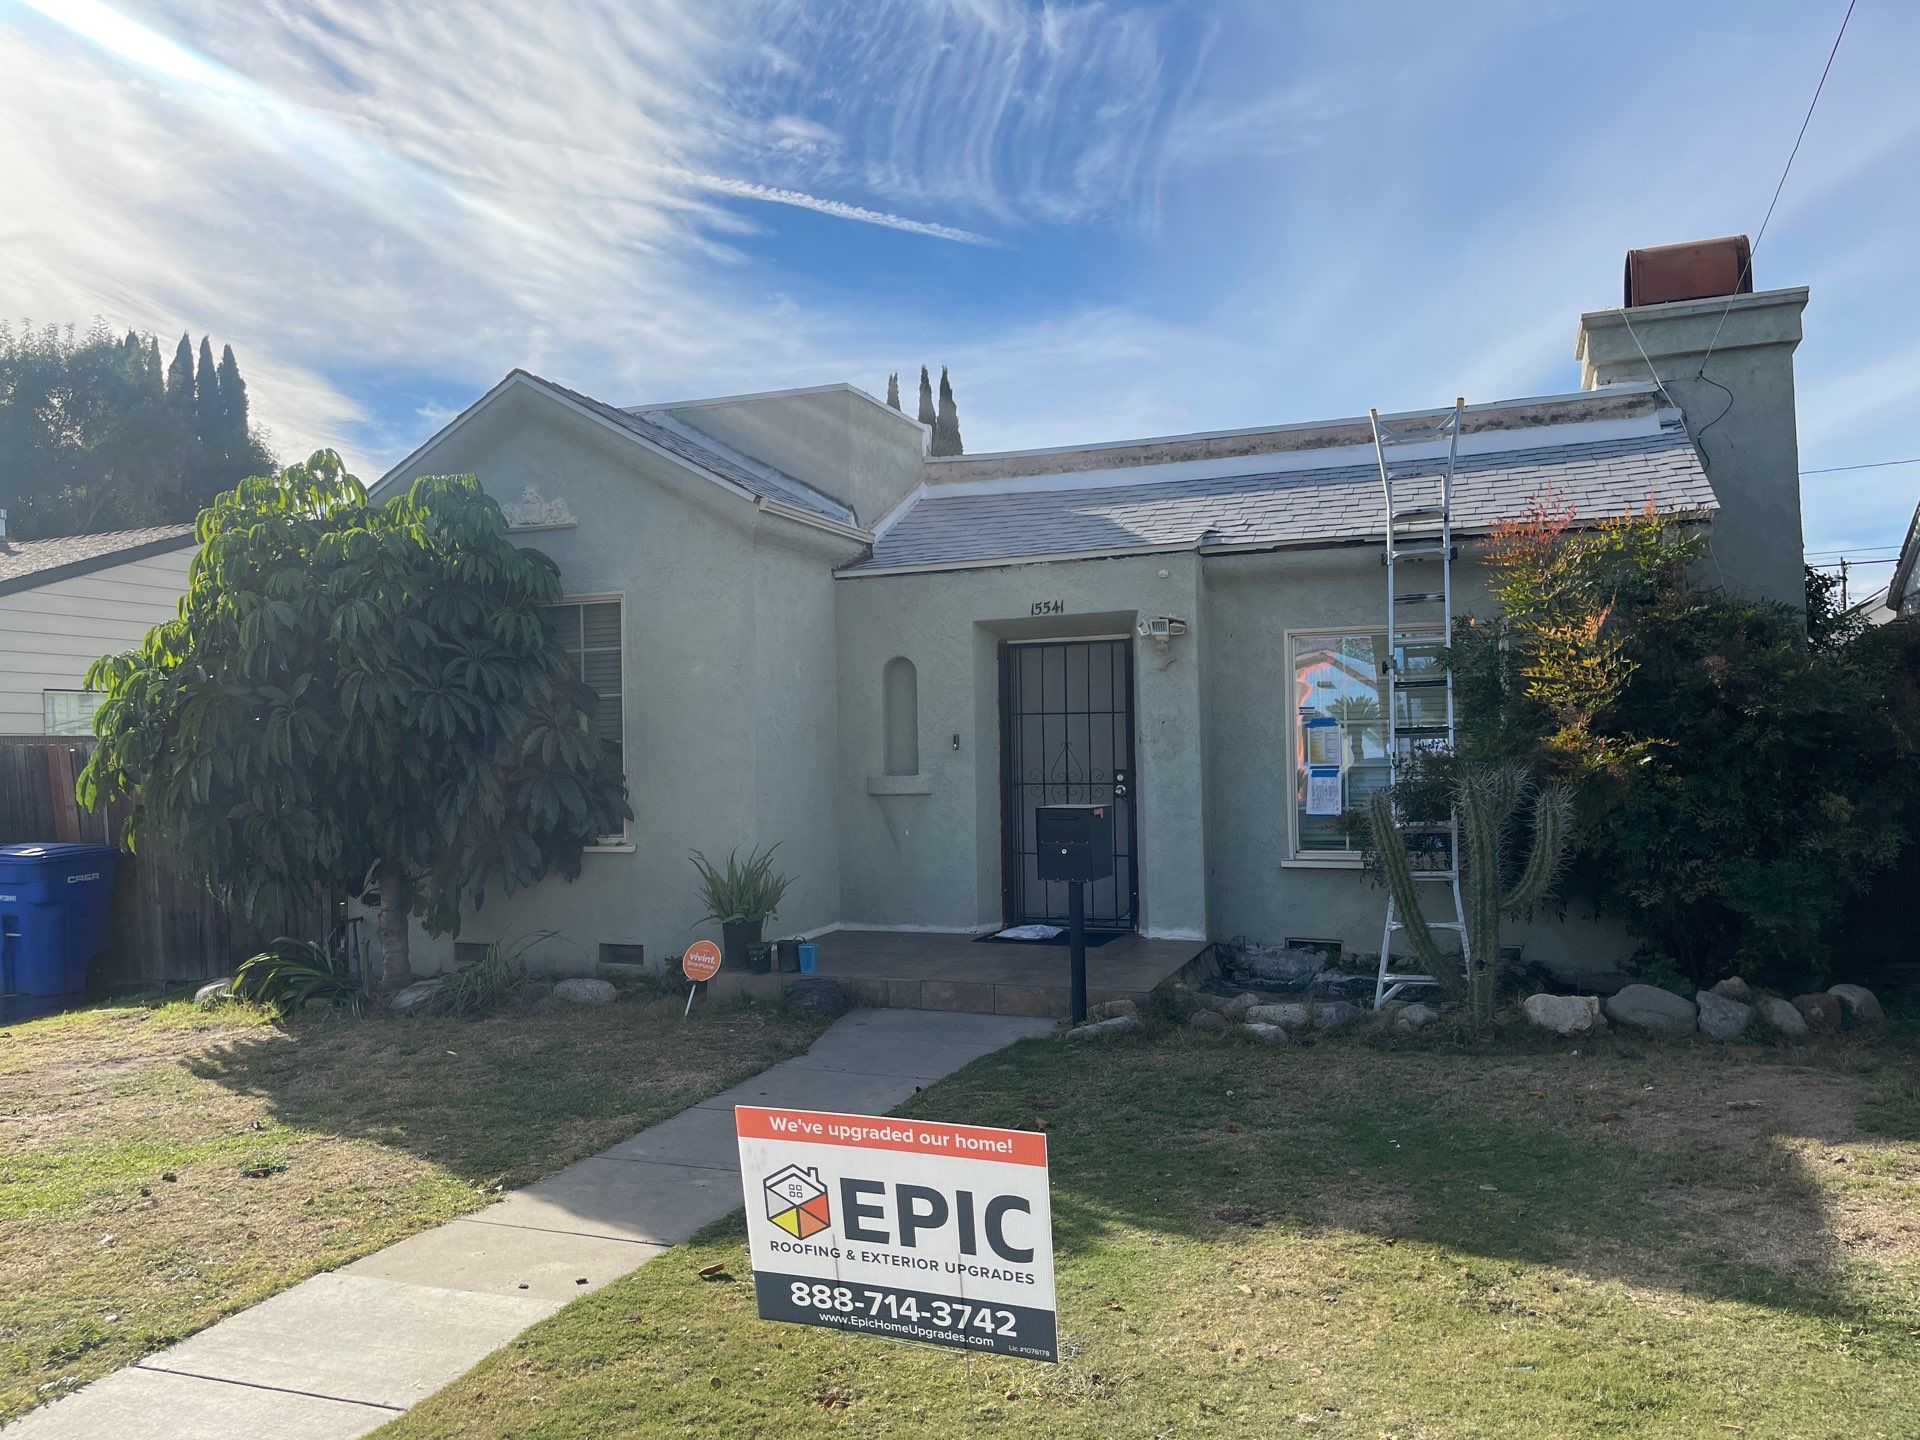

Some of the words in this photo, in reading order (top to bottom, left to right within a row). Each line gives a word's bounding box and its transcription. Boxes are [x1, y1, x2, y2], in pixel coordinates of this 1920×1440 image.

[1031, 600, 1064, 616] 15541
[769, 1116, 823, 1135] We've
[828, 1123, 913, 1143] upgraded
[919, 1132, 950, 1147] our
[955, 1133, 1013, 1154] home!
[839, 1177, 1034, 1264] EPIC
[770, 1240, 841, 1259] ROOFING
[846, 1249, 856, 1261] &
[861, 1251, 940, 1272] EXTERIOR
[945, 1262, 1035, 1285] UPGRADES
[790, 1281, 1018, 1338] 888-714-3742
[819, 1311, 995, 1347] www.EpicHomeUpgrades.com
[1008, 1344, 1019, 1352] Lic
